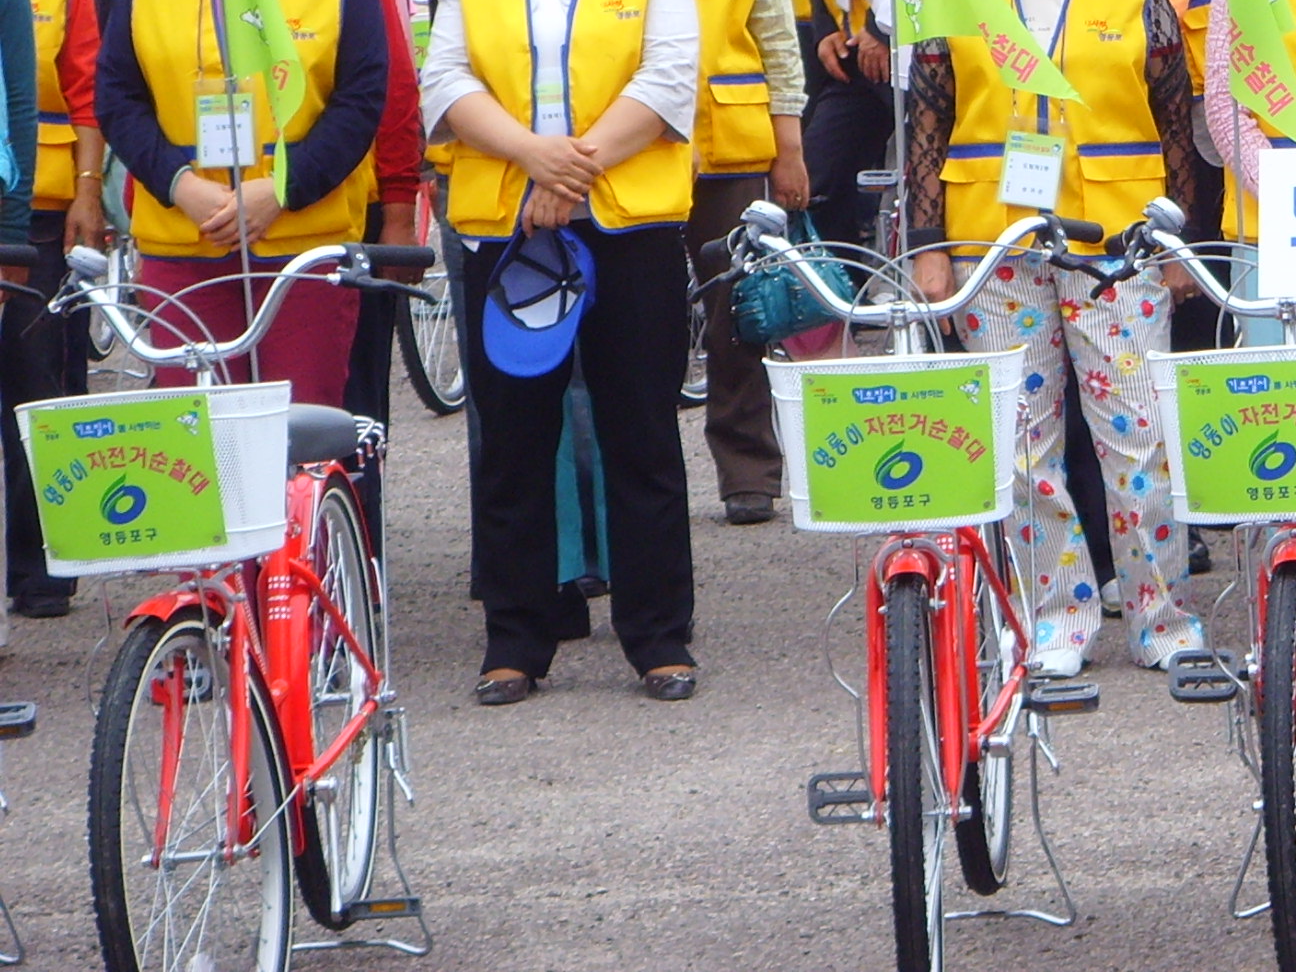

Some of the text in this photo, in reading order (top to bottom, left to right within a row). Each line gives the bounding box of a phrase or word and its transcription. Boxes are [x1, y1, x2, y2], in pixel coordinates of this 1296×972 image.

[978, 22, 1039, 83] 찰대
[864, 413, 987, 464] 자전거순찰대
[86, 446, 210, 496] 자전거순찰대
[871, 494, 931, 509] 영등포구
[99, 528, 158, 545] 영등포구
